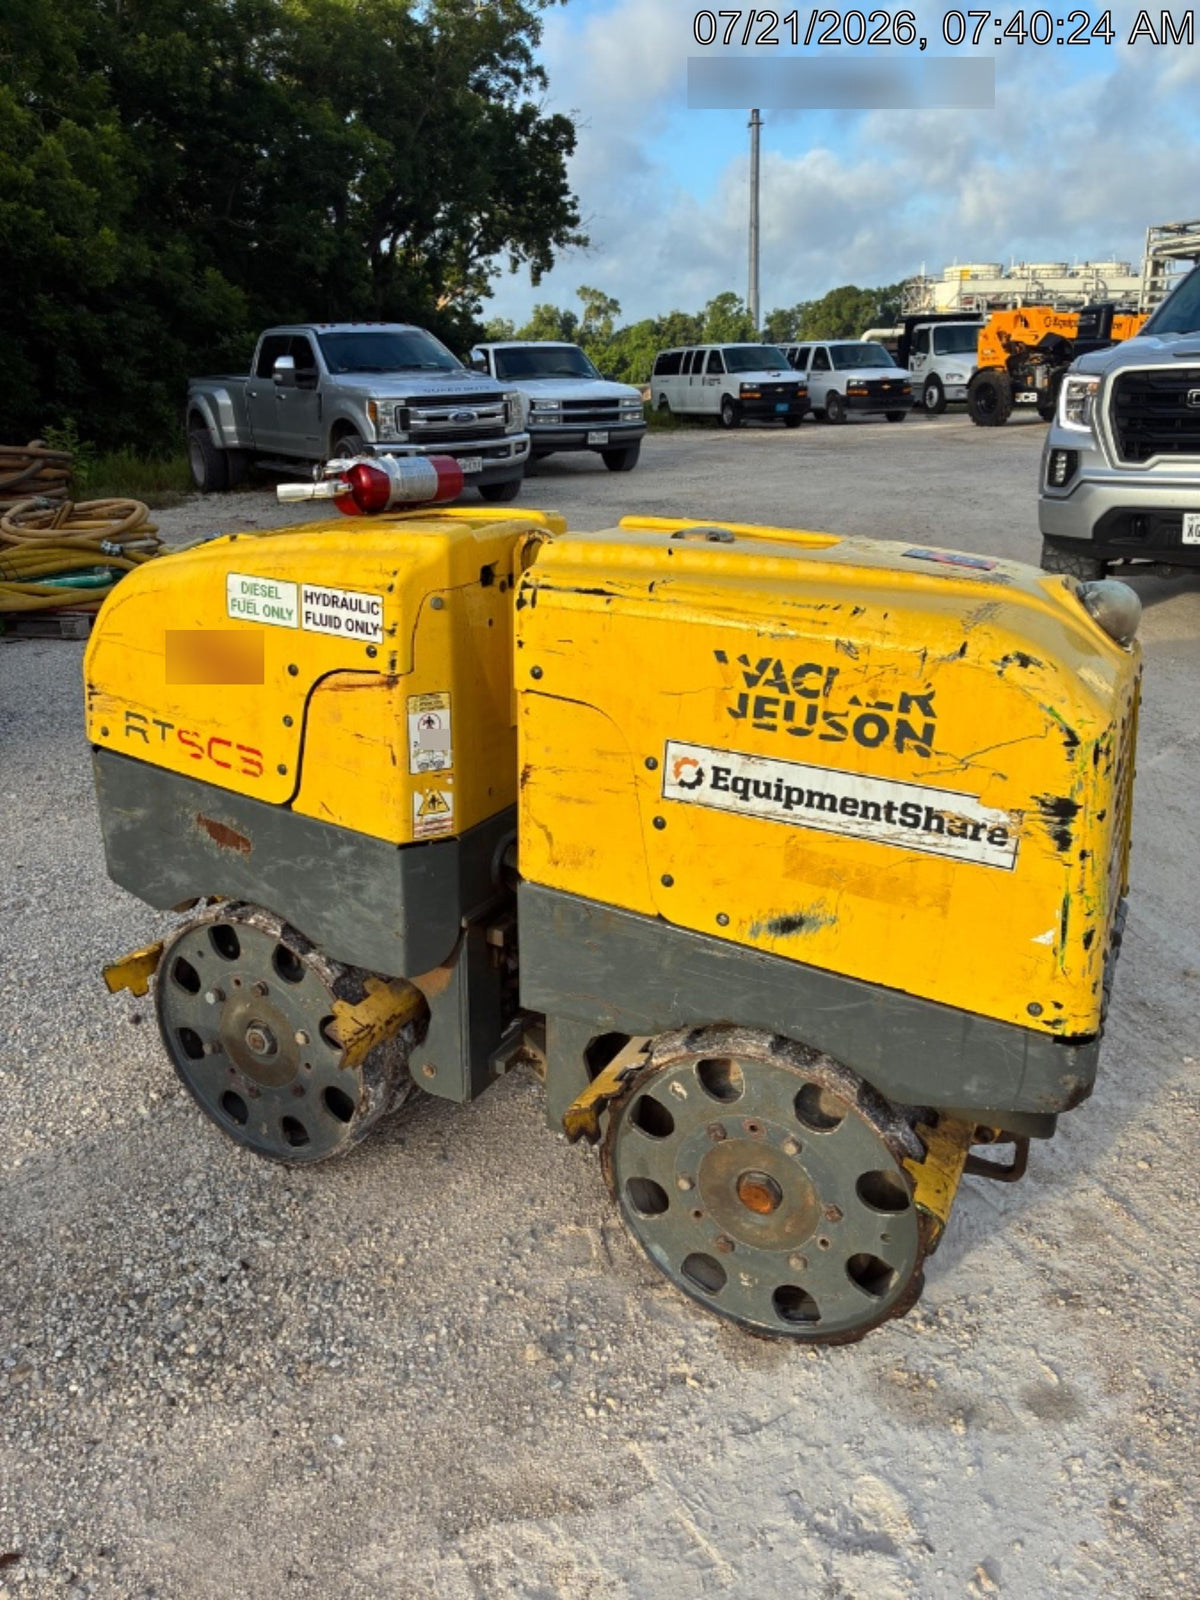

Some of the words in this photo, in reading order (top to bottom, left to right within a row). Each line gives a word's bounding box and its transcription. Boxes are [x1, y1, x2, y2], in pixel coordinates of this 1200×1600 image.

[240, 581, 282, 600] DIESEL
[303, 590, 380, 616] HYDRAULIC
[230, 598, 260, 616] FUEL
[262, 604, 294, 621] ONLY
[304, 611, 342, 630] FLUID
[345, 618, 380, 636] ONLY
[713, 650, 937, 718] WACR
[709, 766, 1009, 848] EquipmentShare
